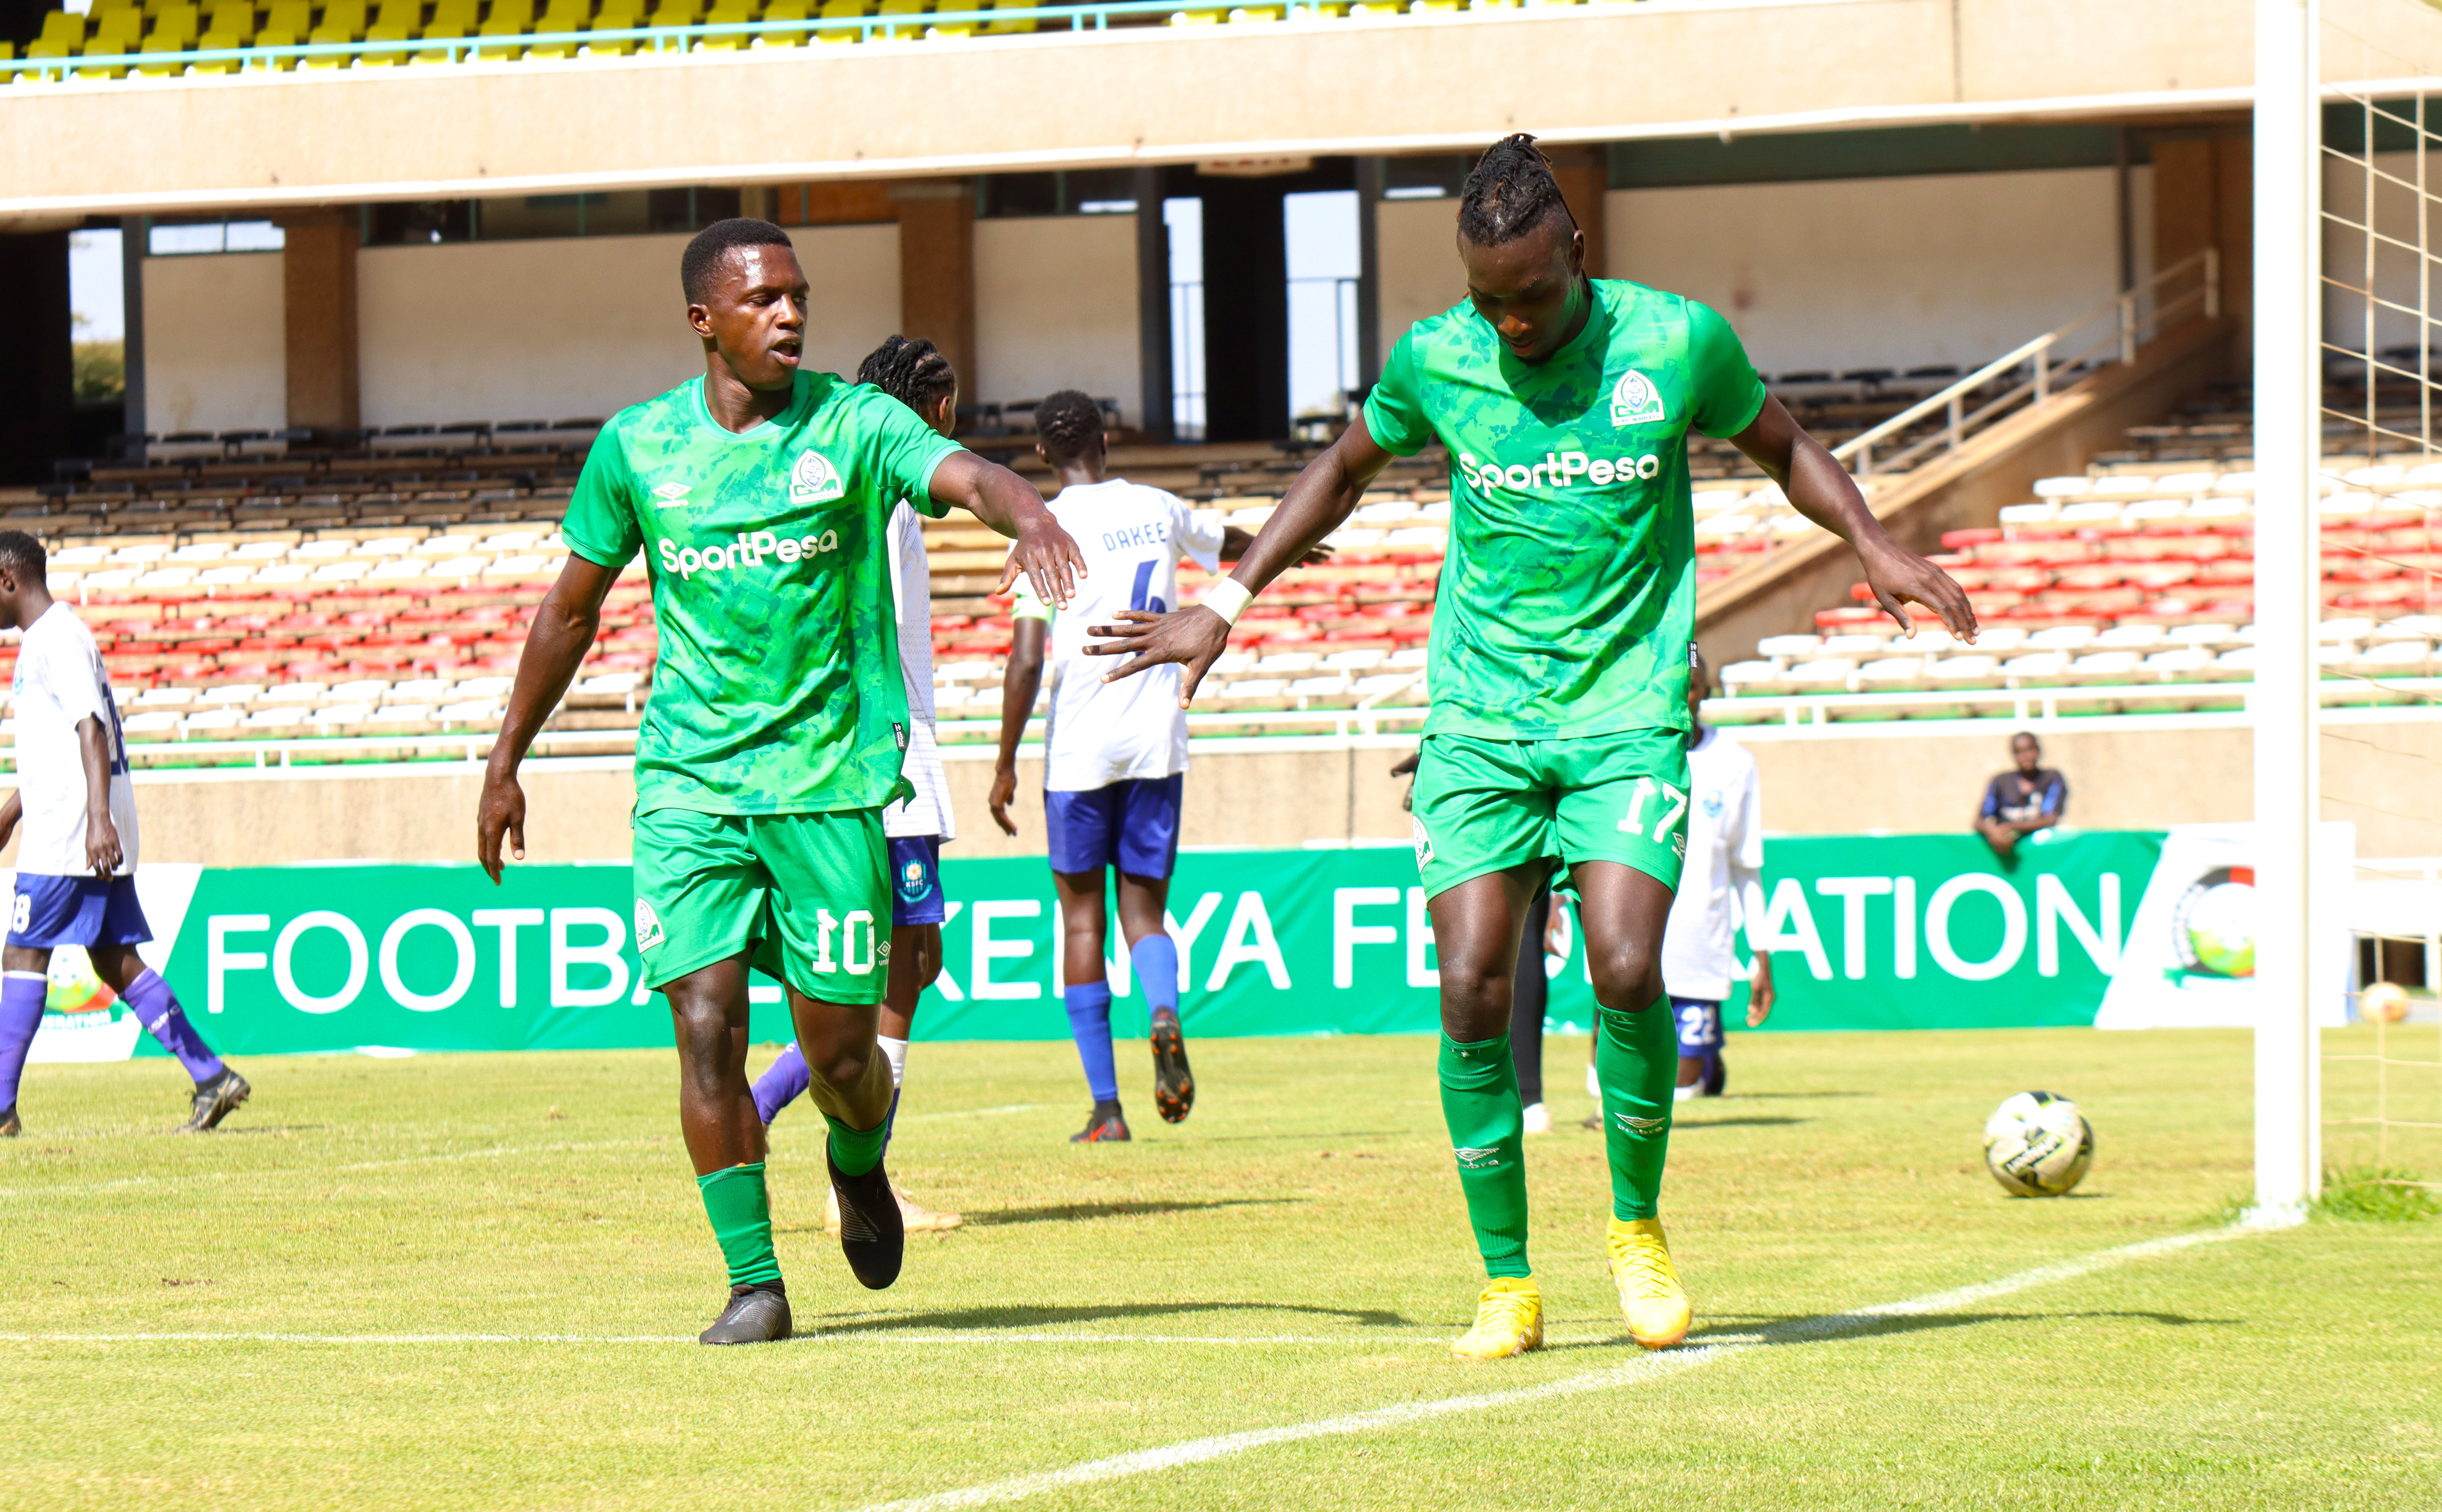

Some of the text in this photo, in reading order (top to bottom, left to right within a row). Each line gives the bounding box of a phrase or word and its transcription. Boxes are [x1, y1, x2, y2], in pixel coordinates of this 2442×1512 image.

[1459, 451, 1659, 498] SportPesa
[659, 529, 838, 581] SportPesa
[1617, 776, 1687, 843] 17
[906, 879, 923, 887] KSFC
[207, 908, 783, 1014] FOOTB
[1333, 872, 2121, 989] FEATION
[812, 909, 875, 975] 10
[879, 957, 889, 966] umb
